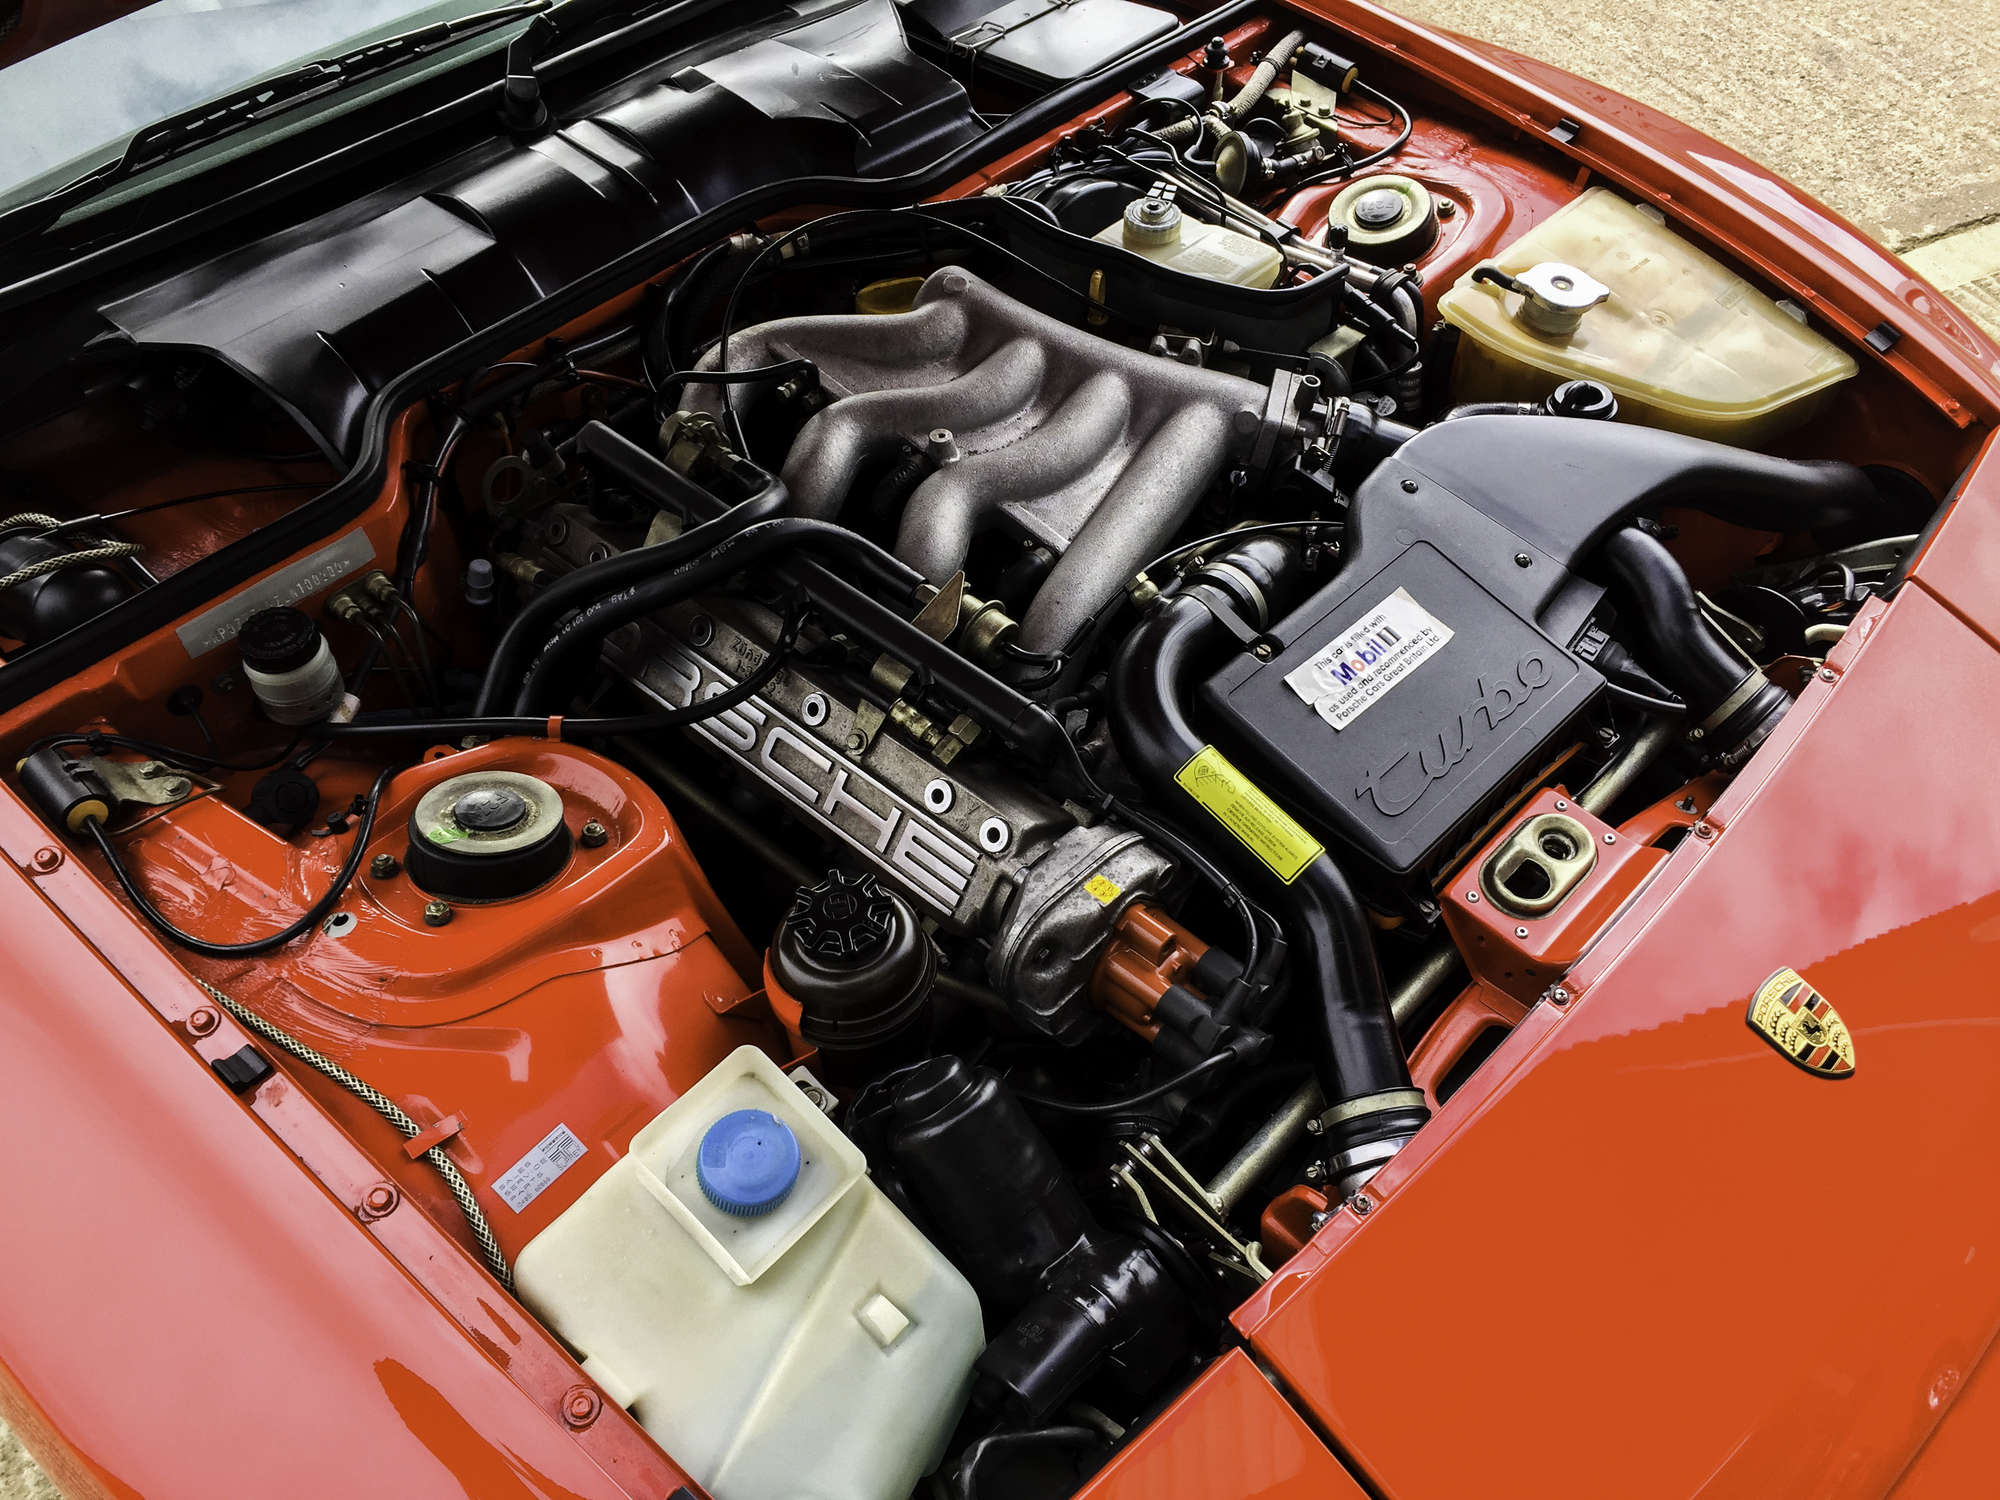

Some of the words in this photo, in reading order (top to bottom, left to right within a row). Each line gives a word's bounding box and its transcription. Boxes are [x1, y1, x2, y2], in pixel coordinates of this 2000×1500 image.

[1314, 655, 1333, 671] This
[1332, 646, 1344, 660] car
[1345, 639, 1354, 650] is
[1351, 626, 1371, 644] filled
[1370, 613, 1387, 630] with
[1328, 703, 1340, 714] as
[1338, 686, 1359, 705] used
[1358, 673, 1375, 690] and
[1421, 625, 1434, 639] by
[1330, 639, 1387, 686] Mobil
[1335, 694, 1369, 722] Porsche
[1366, 680, 1386, 698] Cars
[1384, 662, 1407, 683] Great
[1405, 645, 1429, 667] Britain
[1355, 651, 1552, 818] turbo
[1755, 972, 1799, 1026] PORSCHE
